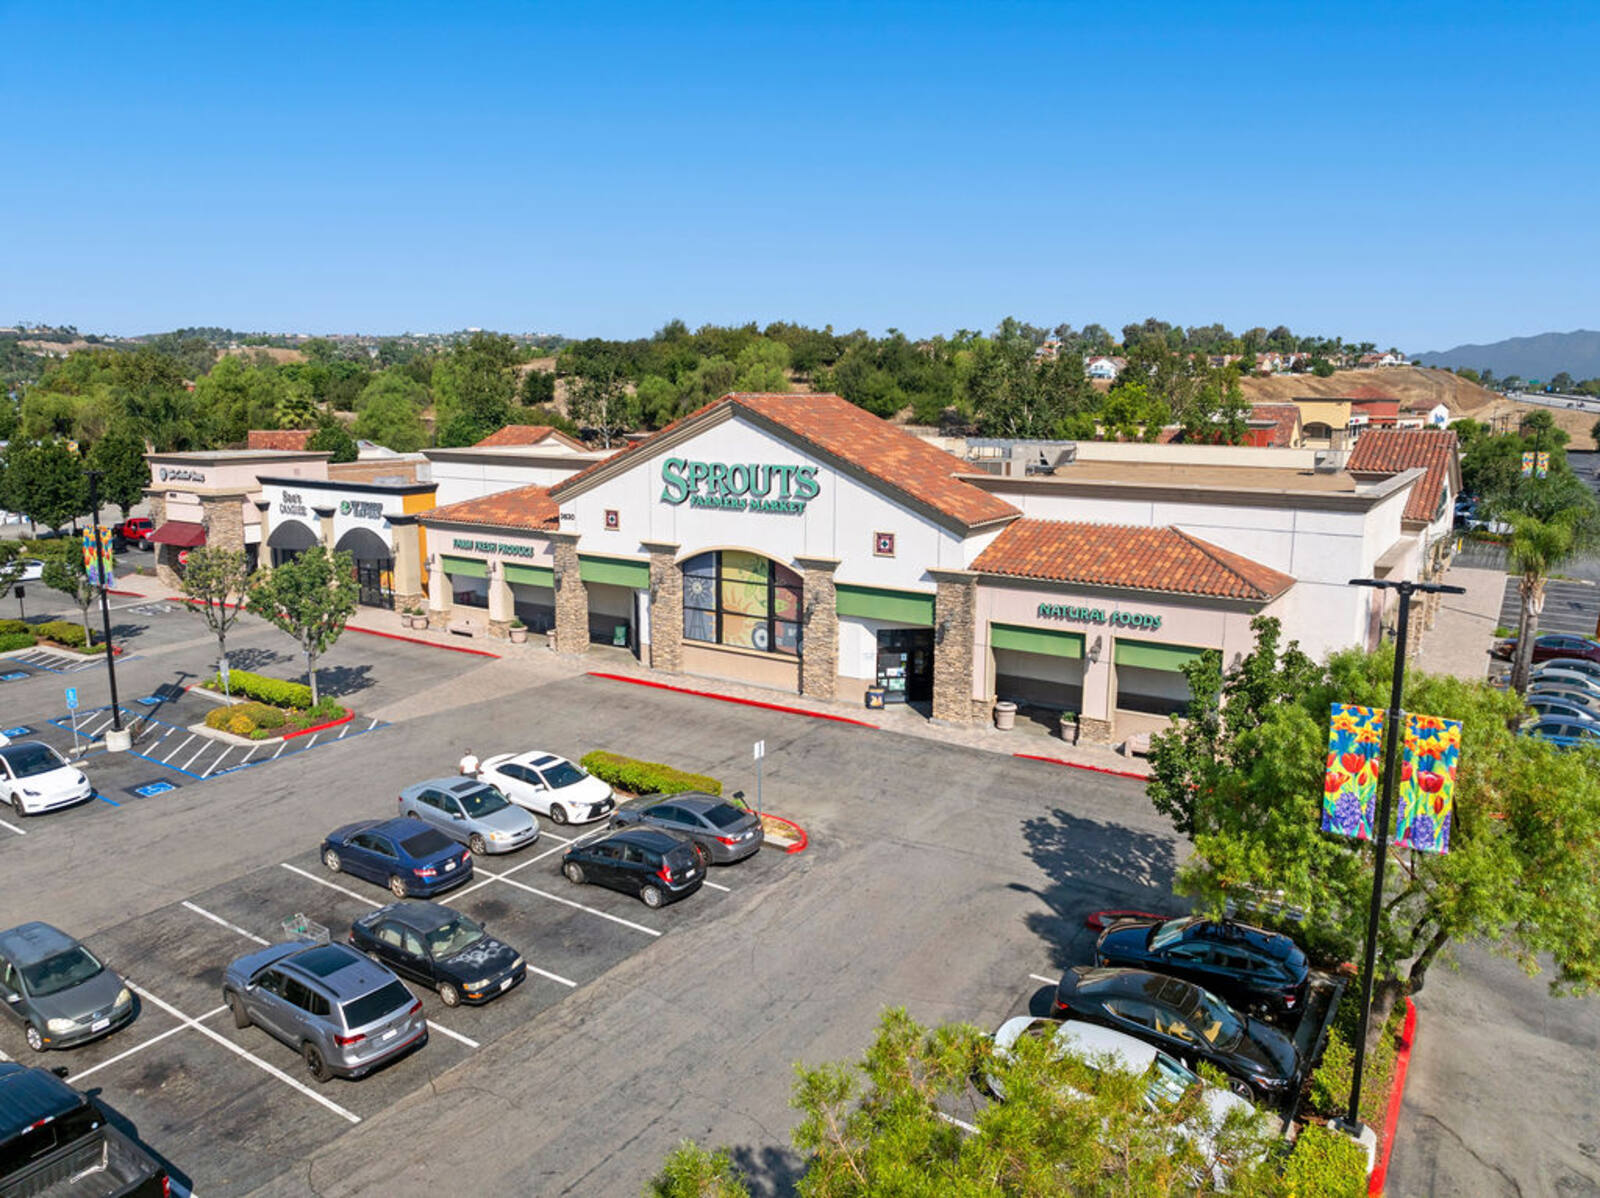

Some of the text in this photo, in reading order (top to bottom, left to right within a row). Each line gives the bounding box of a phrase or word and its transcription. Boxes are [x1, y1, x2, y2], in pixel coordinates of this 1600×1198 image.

[661, 457, 821, 505] SPROUTS
[690, 494, 806, 514] FARMERS MARKET
[498, 542, 535, 558] PRODUCE
[1039, 602, 1162, 630] NATURAL FOODS
